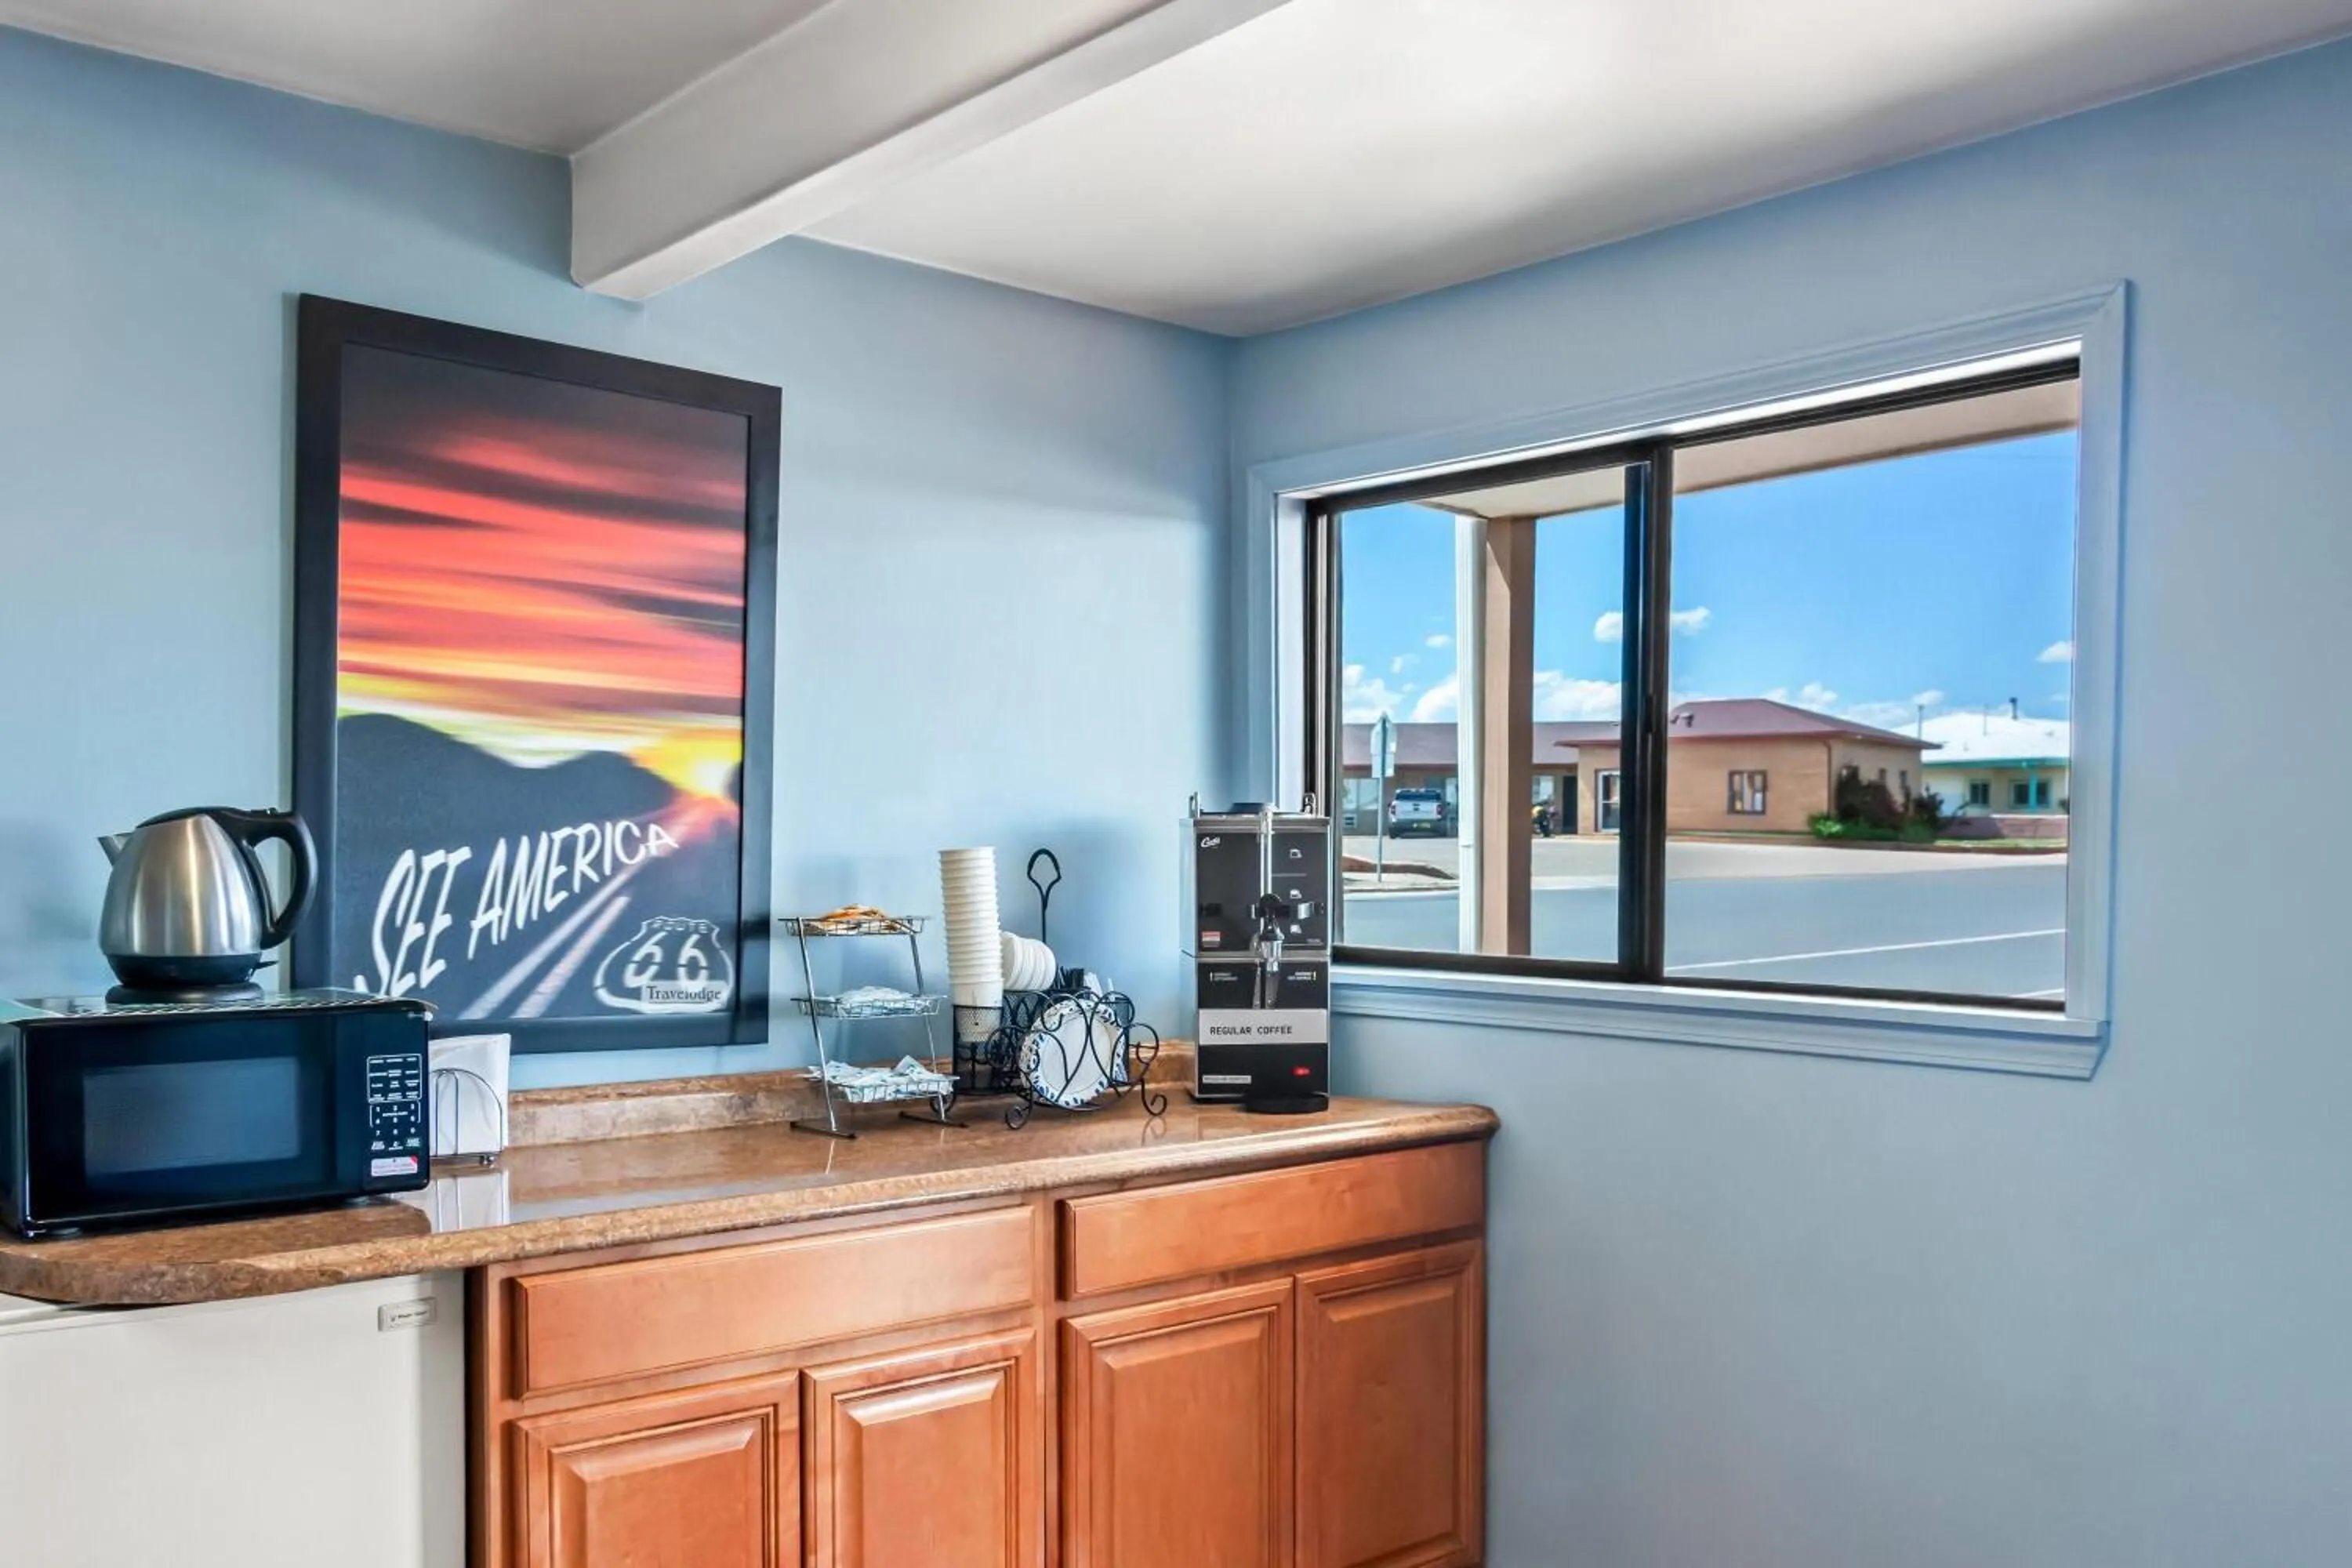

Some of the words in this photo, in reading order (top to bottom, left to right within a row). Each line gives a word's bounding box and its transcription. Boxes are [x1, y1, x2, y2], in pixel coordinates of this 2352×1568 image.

[354, 846, 472, 998] SEE
[467, 820, 679, 960] AMERICA
[622, 931, 710, 989] 66
[1210, 1025, 1252, 1036] REGULAR
[1257, 1025, 1293, 1035] COFFEE
